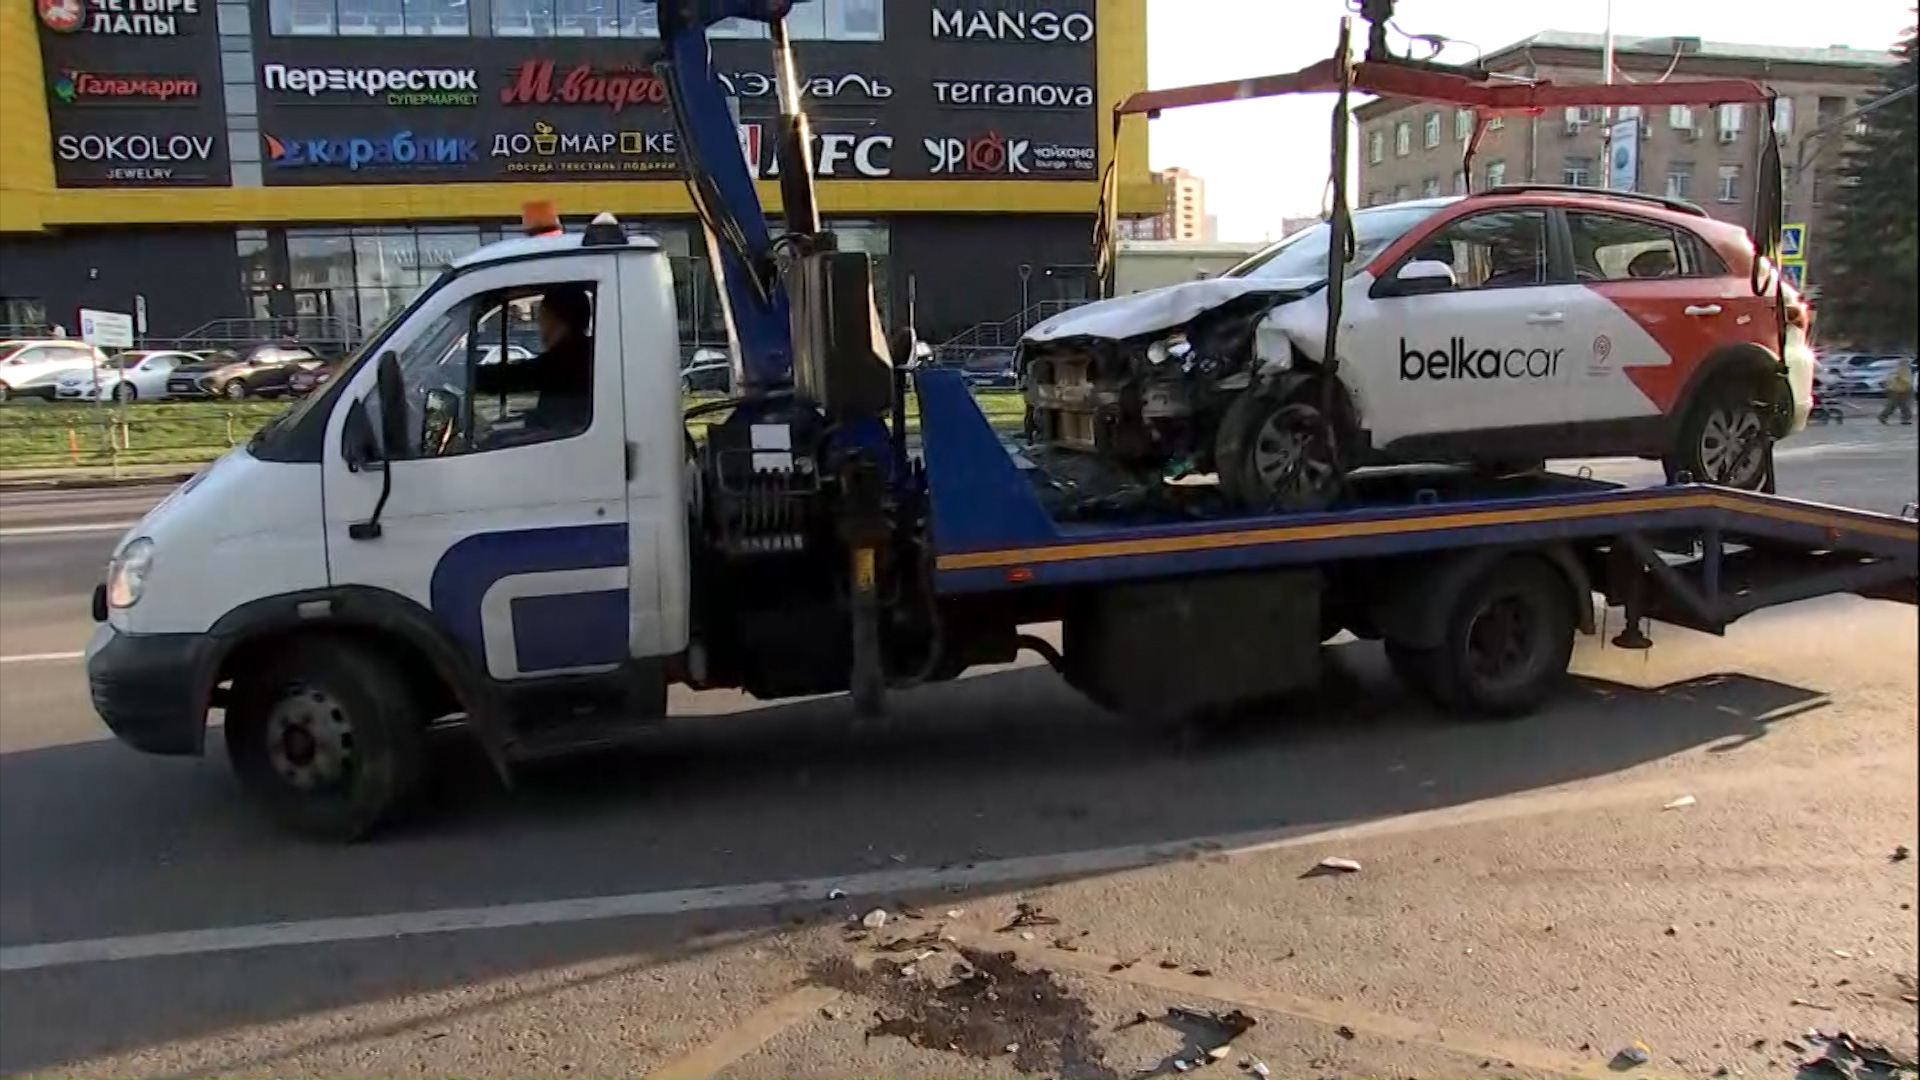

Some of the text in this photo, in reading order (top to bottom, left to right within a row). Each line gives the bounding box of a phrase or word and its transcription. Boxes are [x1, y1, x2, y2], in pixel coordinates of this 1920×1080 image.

[92, 13, 176, 35] ЛАПЫ
[932, 8, 1094, 42] MANGO
[77, 75, 198, 100] Галамарт
[264, 63, 479, 96] Перекресток
[388, 94, 479, 106] СУПЕРМАРКЕТ
[58, 135, 213, 160] SOKOLOV
[308, 131, 479, 170] кораблик
[766, 133, 893, 176] FC
[924, 134, 1030, 173] УРЮК
[106, 169, 173, 179] JEWELRY
[1400, 336, 1565, 380] belkacar
